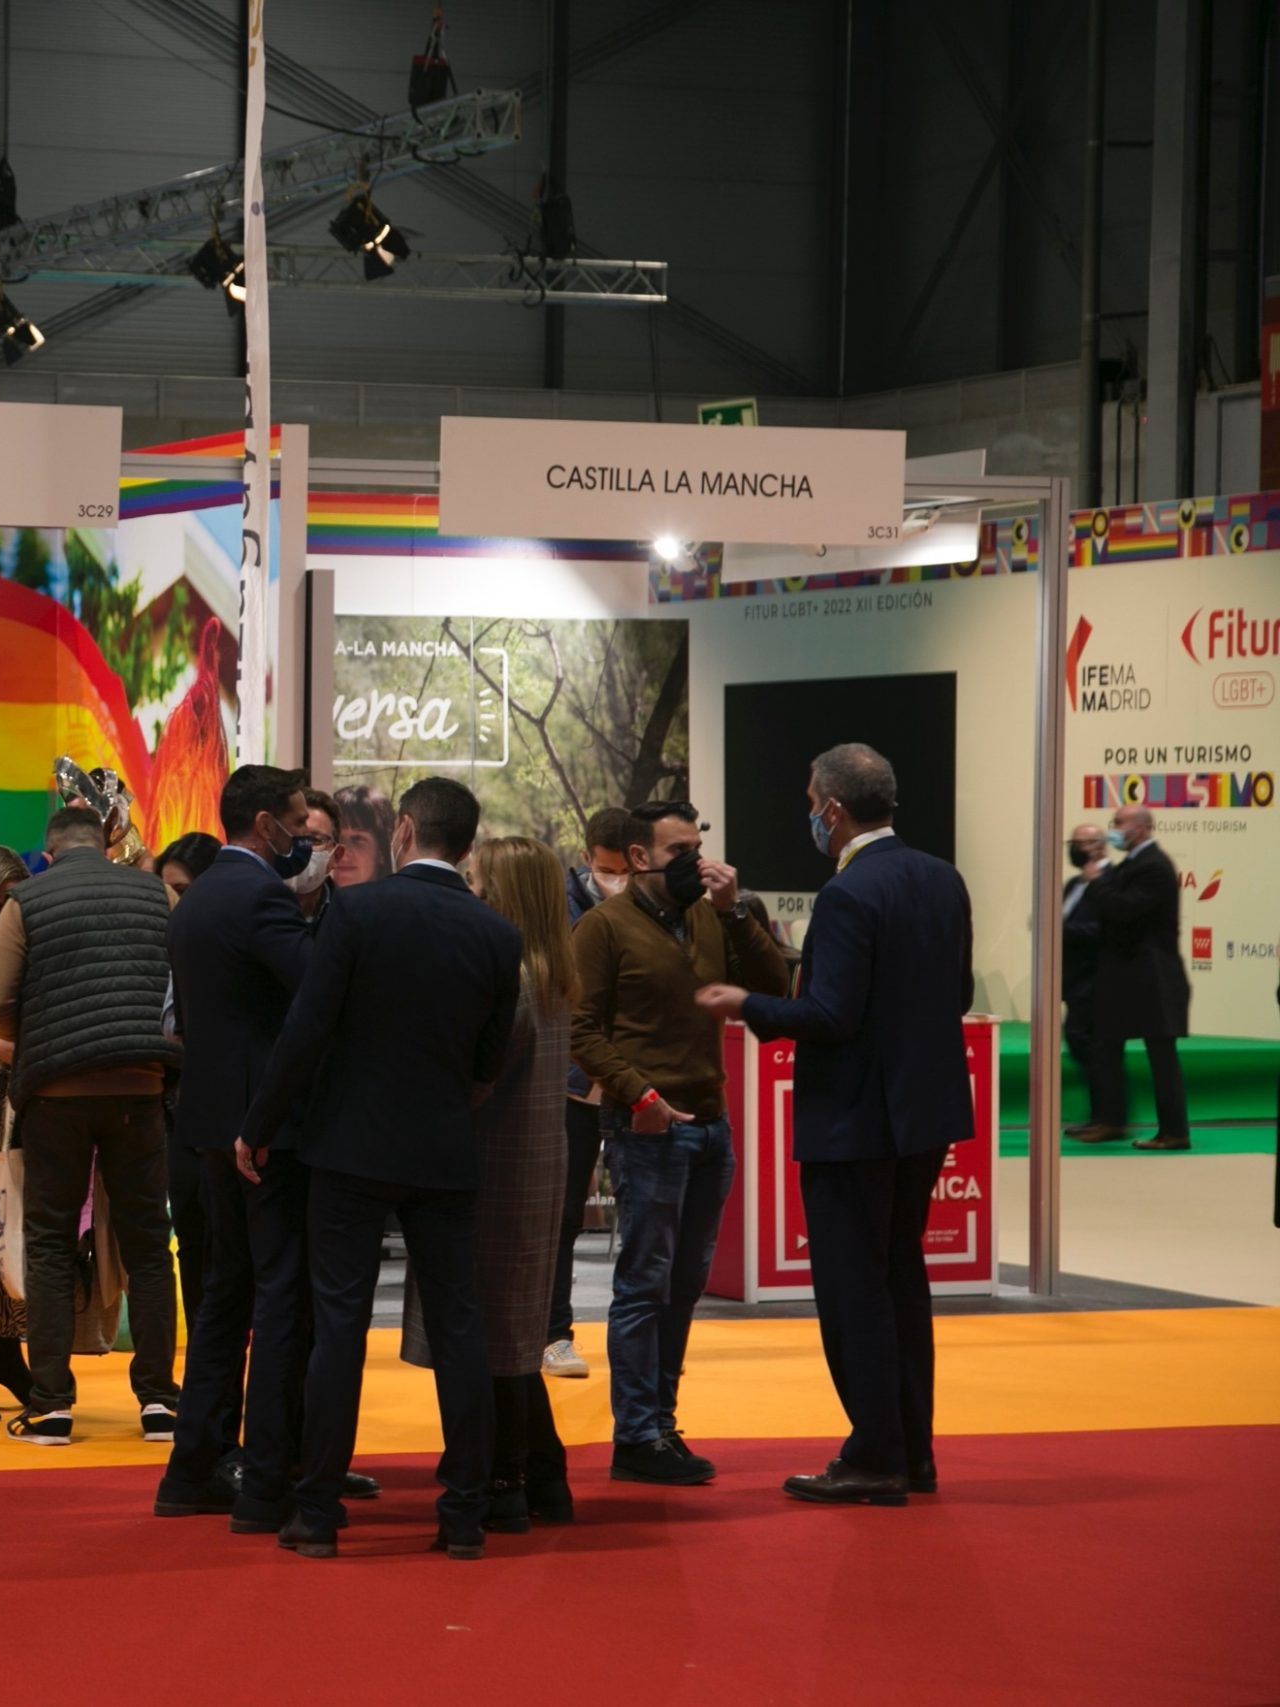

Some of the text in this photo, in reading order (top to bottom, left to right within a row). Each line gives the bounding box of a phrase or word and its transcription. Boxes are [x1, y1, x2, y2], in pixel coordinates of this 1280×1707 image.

[546, 464, 814, 500] CASTILLA LA MANCHA
[77, 504, 114, 519] 3C29
[867, 525, 900, 540] 3C31
[744, 604, 778, 621] FITUR
[823, 597, 852, 615] 2022
[856, 596, 873, 613] XII
[877, 588, 933, 612] EDICIÓN
[382, 641, 460, 657] MANCHA
[1081, 663, 1136, 687] IFEMA
[1081, 687, 1151, 713] MADRID
[1221, 677, 1267, 703] LGBT+
[1104, 744, 1252, 765] POR UN TURISMO
[1150, 820, 1248, 834] NCLUSIVE TOURISM
[777, 896, 804, 912] POR
